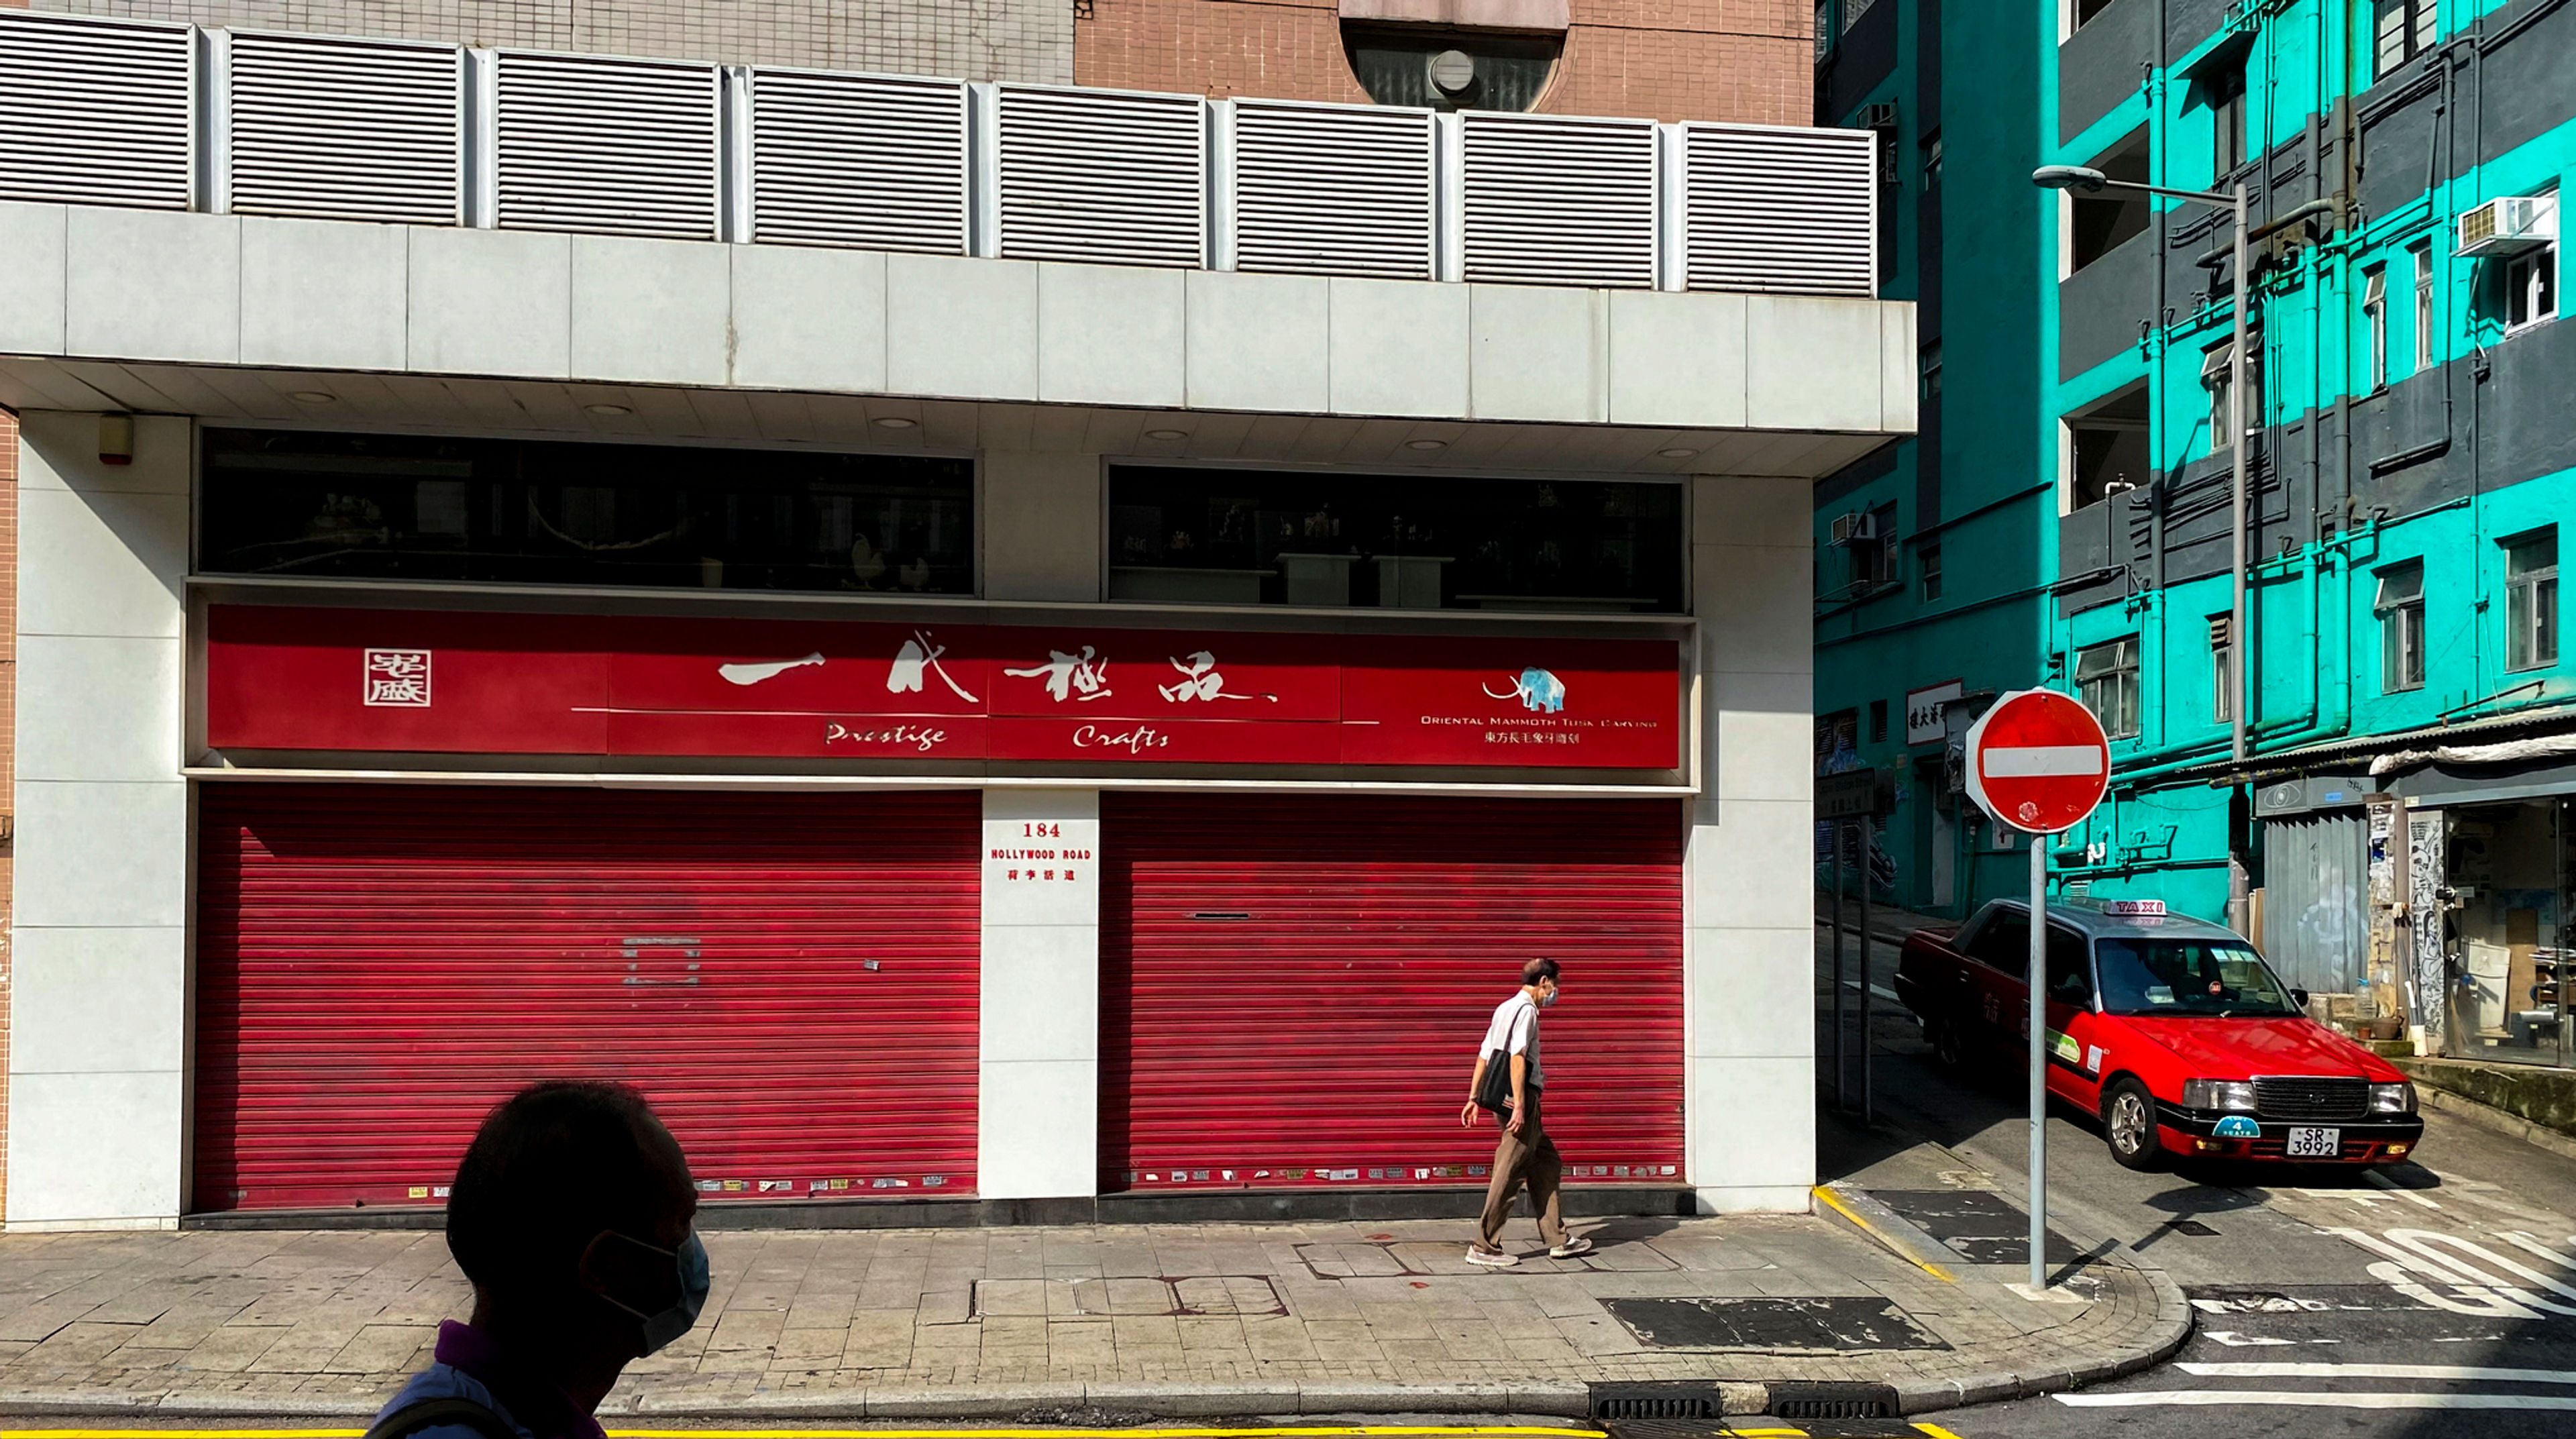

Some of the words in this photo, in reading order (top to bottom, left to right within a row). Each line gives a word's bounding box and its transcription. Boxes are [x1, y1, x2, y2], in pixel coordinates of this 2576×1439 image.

[1421, 716, 1484, 725] ORIENTAL
[1490, 717, 1556, 726] MAMMOTH
[826, 722, 948, 751] Prestige
[1073, 725, 1168, 754] Crafts
[1024, 822, 1060, 837] 184
[991, 849, 1055, 859] HOLLYWOOD
[1063, 850, 1091, 859] ROAD
[2116, 902, 2163, 912] TAXI
[2233, 1122, 2242, 1130] 4
[2304, 1129, 2324, 1142] SR
[2292, 1141, 2334, 1155] 3992
